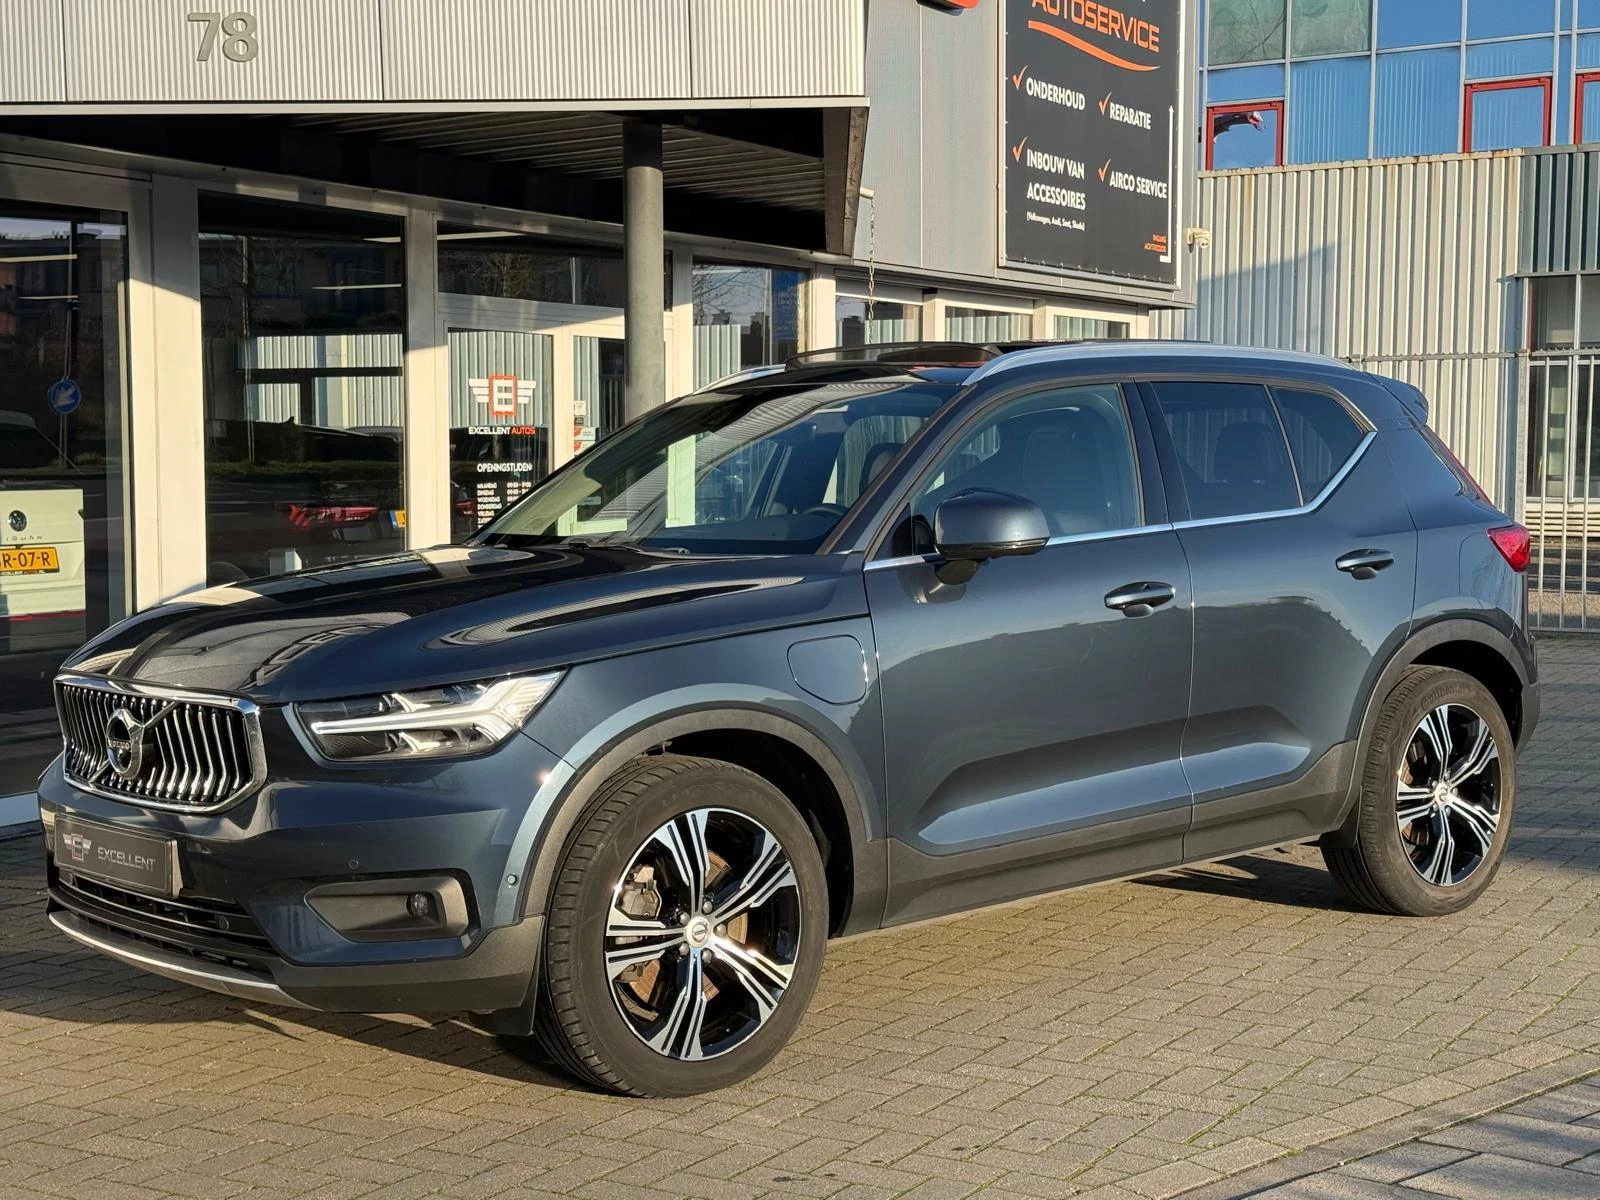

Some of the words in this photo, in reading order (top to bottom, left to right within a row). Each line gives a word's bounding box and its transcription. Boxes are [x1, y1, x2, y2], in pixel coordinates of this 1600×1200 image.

[187, 12, 259, 63] 78
[1026, 77, 1086, 110] ONDERHOUD
[1109, 102, 1151, 130] REPARATIE
[1026, 149, 1066, 175] INBOUW
[1066, 158, 1085, 180] VAN
[1026, 182, 1086, 210] ACCESSOIRES
[1109, 170, 1135, 192] AIRCO
[1136, 176, 1168, 199] SERVICE
[468, 426, 511, 435] EXCELLENT
[511, 426, 537, 435] AUTOS
[0, 551, 52, 569] R-07-R
[97, 846, 156, 873] EXCELLENT
